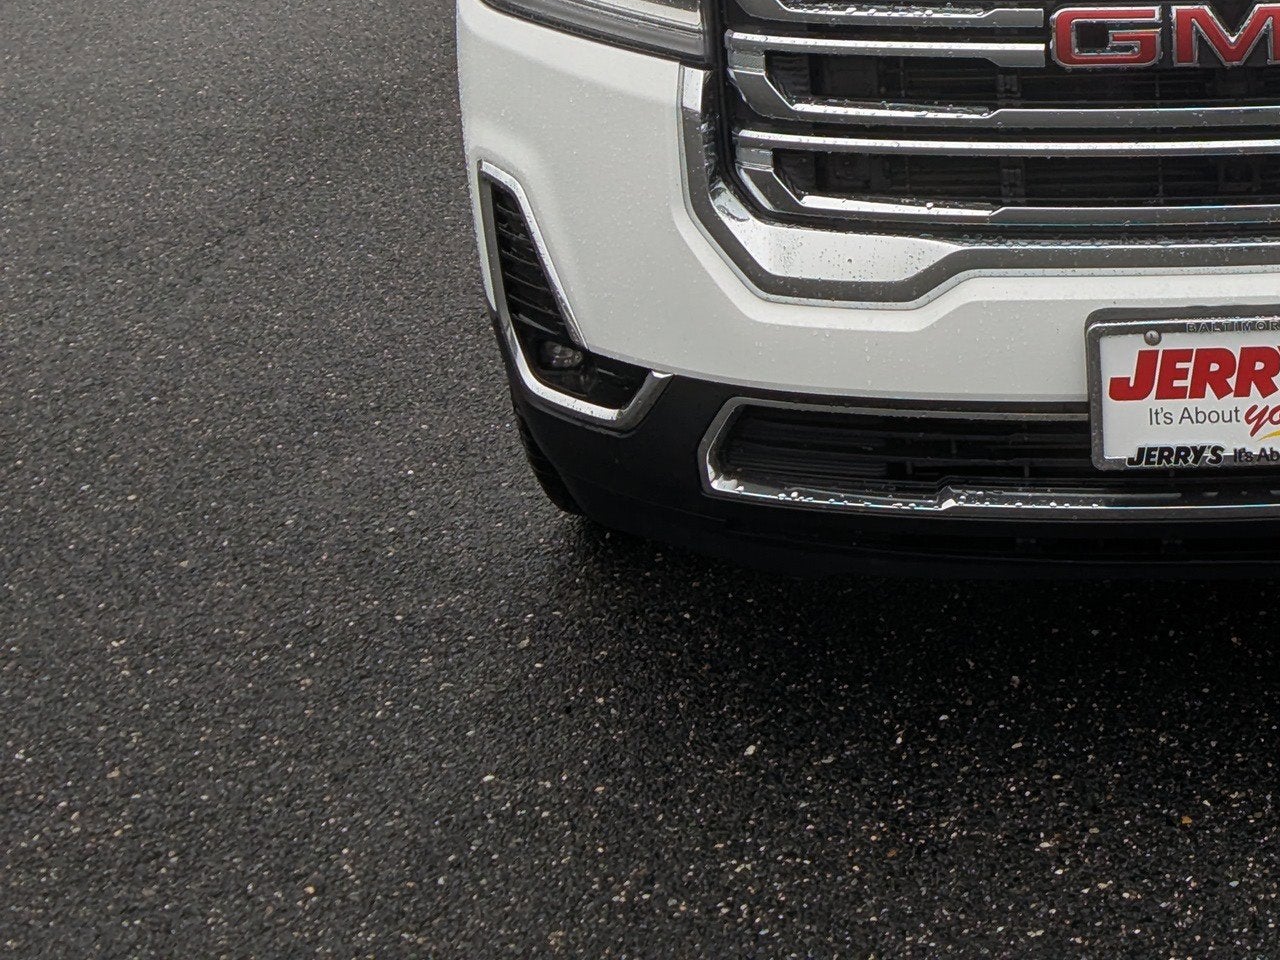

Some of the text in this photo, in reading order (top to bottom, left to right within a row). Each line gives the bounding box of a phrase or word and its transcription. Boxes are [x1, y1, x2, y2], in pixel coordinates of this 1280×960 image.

[1149, 406, 1174, 426] It's
[1178, 406, 1240, 426] About
[1127, 445, 1226, 467] JERRY'S
[1233, 447, 1253, 464] It's
